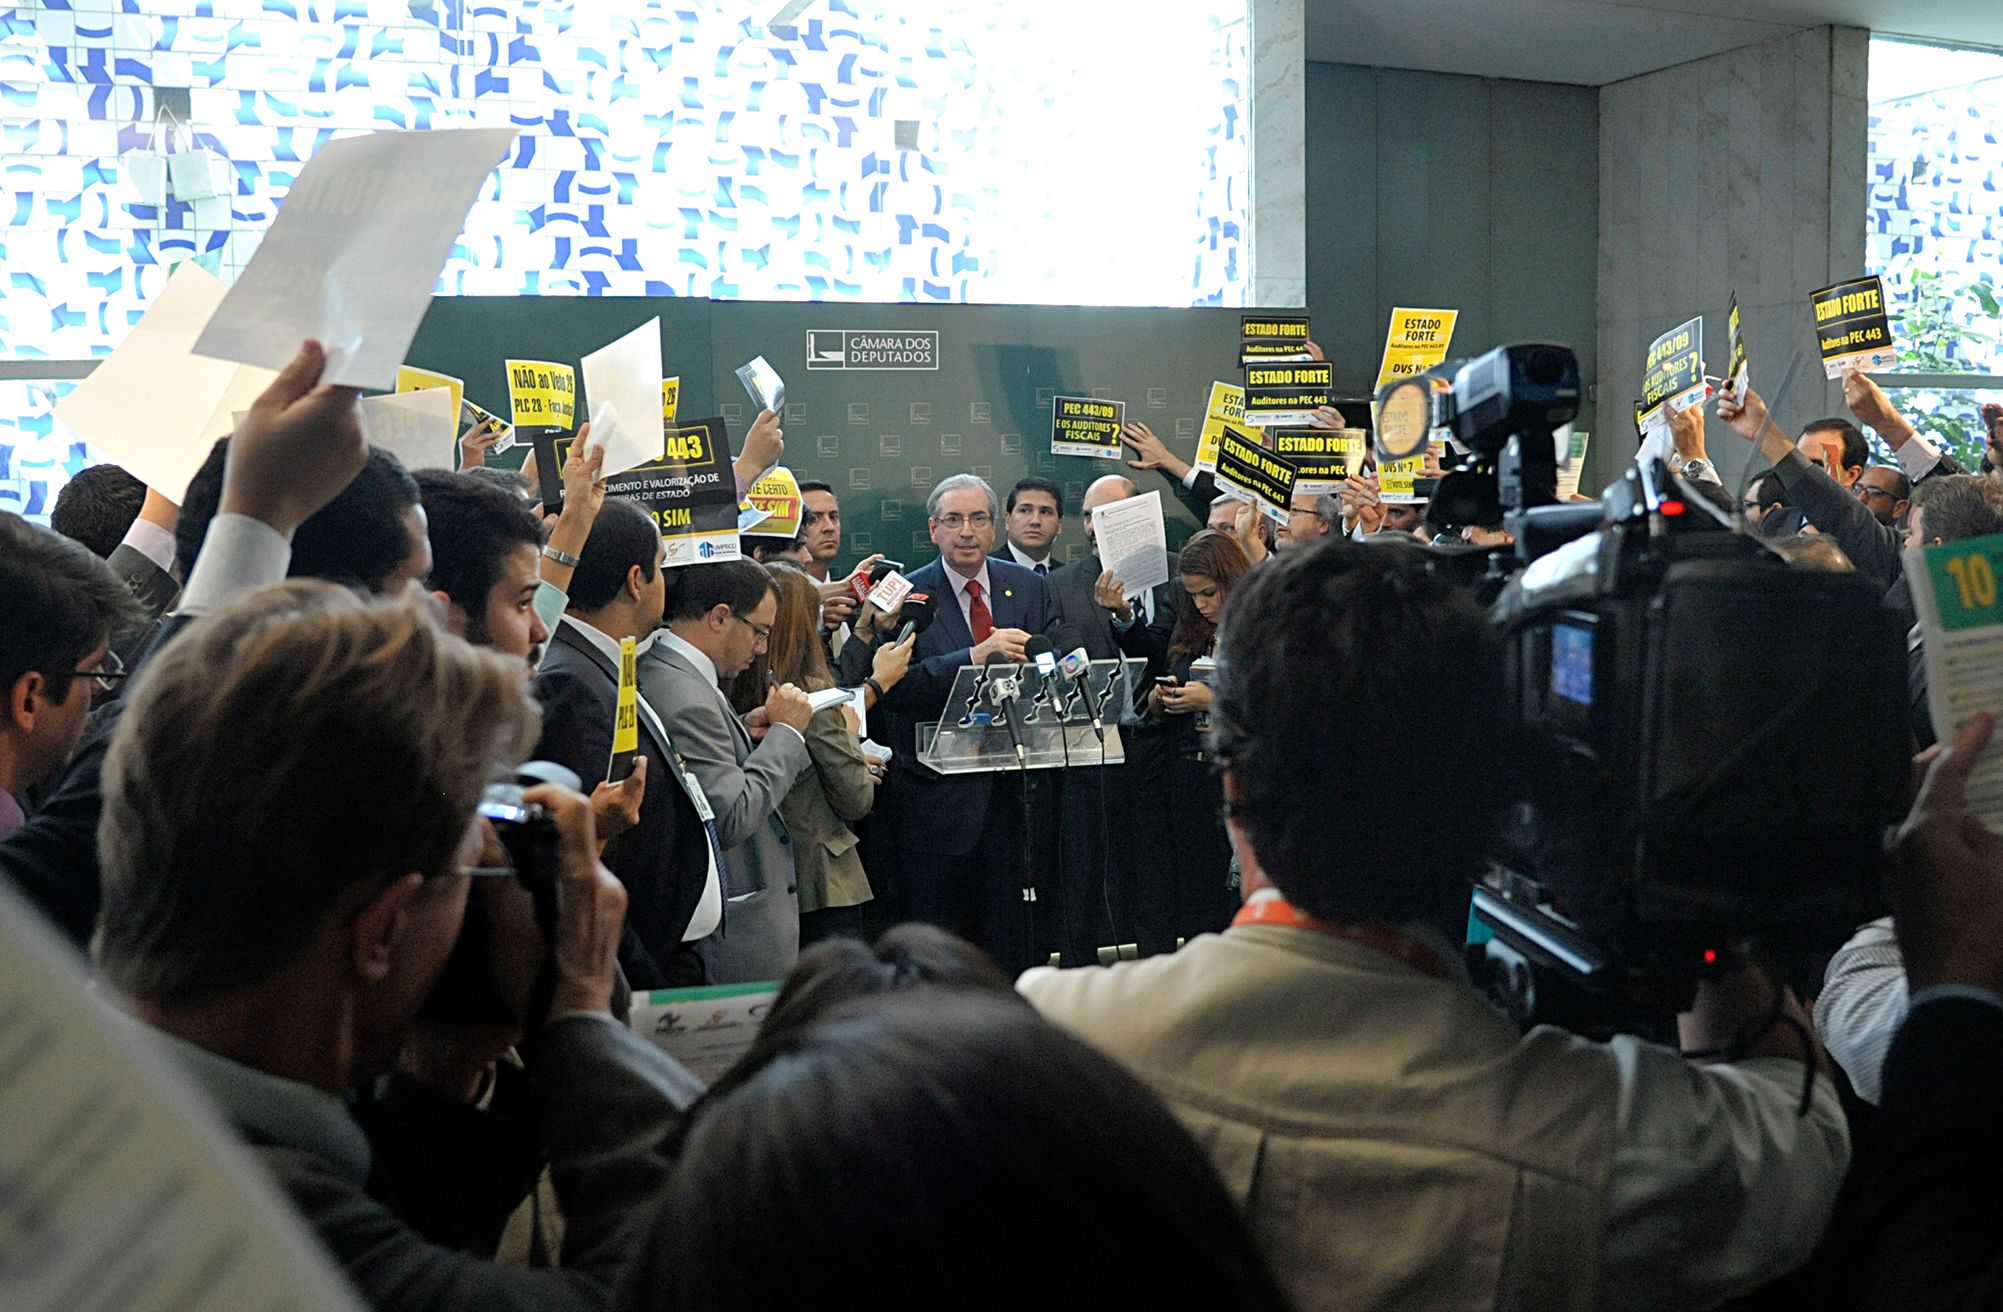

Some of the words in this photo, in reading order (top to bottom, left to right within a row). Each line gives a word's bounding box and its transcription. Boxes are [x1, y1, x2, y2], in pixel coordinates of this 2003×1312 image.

[1815, 296, 1842, 322] ESTADO
[1842, 288, 1879, 314] FORTE
[1245, 323, 1278, 336] ESTADO
[1280, 324, 1306, 336] FORTE
[1404, 318, 1441, 330] ESTADO
[850, 335, 903, 350] CÂMARA
[906, 338, 931, 350] DOS
[1406, 331, 1436, 342] FORTE
[1841, 334, 1850, 346] na
[1850, 330, 1865, 344] PEC
[1865, 327, 1882, 341] 443
[1656, 331, 1690, 360] 443/09
[851, 351, 931, 362] DEPUTADOS
[1392, 364, 1413, 374] DVS
[1689, 351, 1698, 382] ?
[513, 366, 536, 389] NÃO
[538, 374, 550, 389] ao
[550, 371, 566, 391] Veto
[1249, 370, 1292, 384] ESTADO
[1294, 370, 1329, 383] FORTE
[1646, 376, 1678, 405] FISCAIS
[514, 398, 530, 413] PLC
[532, 398, 542, 412] 28
[1223, 393, 1245, 406] ESTA
[1251, 396, 1287, 405] Auditores
[1299, 396, 1312, 404] PEC
[1313, 396, 1328, 404] 443
[1064, 402, 1081, 415] PEC
[1082, 404, 1114, 418] 443/09
[1056, 419, 1060, 428] E
[1061, 420, 1070, 429] OS
[1072, 420, 1111, 432] AUDITORES
[1111, 423, 1120, 444] ?
[1065, 430, 1101, 441] FISCAIS
[667, 435, 703, 460] 443
[1278, 437, 1325, 452] ESTADO
[1326, 438, 1361, 453] FORTE
[1223, 437, 1260, 467] ESTADO
[1260, 457, 1293, 485] FORTE
[1384, 462, 1397, 472] DVS
[1408, 462, 1413, 472] 7
[1330, 466, 1346, 475] PEC
[643, 481, 648, 490] E
[649, 474, 707, 488] VALORIZAÇÃO
[709, 473, 720, 482] DE
[763, 484, 788, 495] CERTO
[1221, 462, 1252, 484] Auditores
[1252, 479, 1262, 488] na
[1261, 483, 1273, 496] PEC
[1272, 491, 1285, 503] 443
[642, 492, 654, 500] DE
[656, 489, 691, 500] ESTADO
[767, 500, 791, 518] SIM
[664, 508, 691, 528] SIM
[876, 577, 902, 600] TUPI
[1946, 554, 1997, 612] 10
